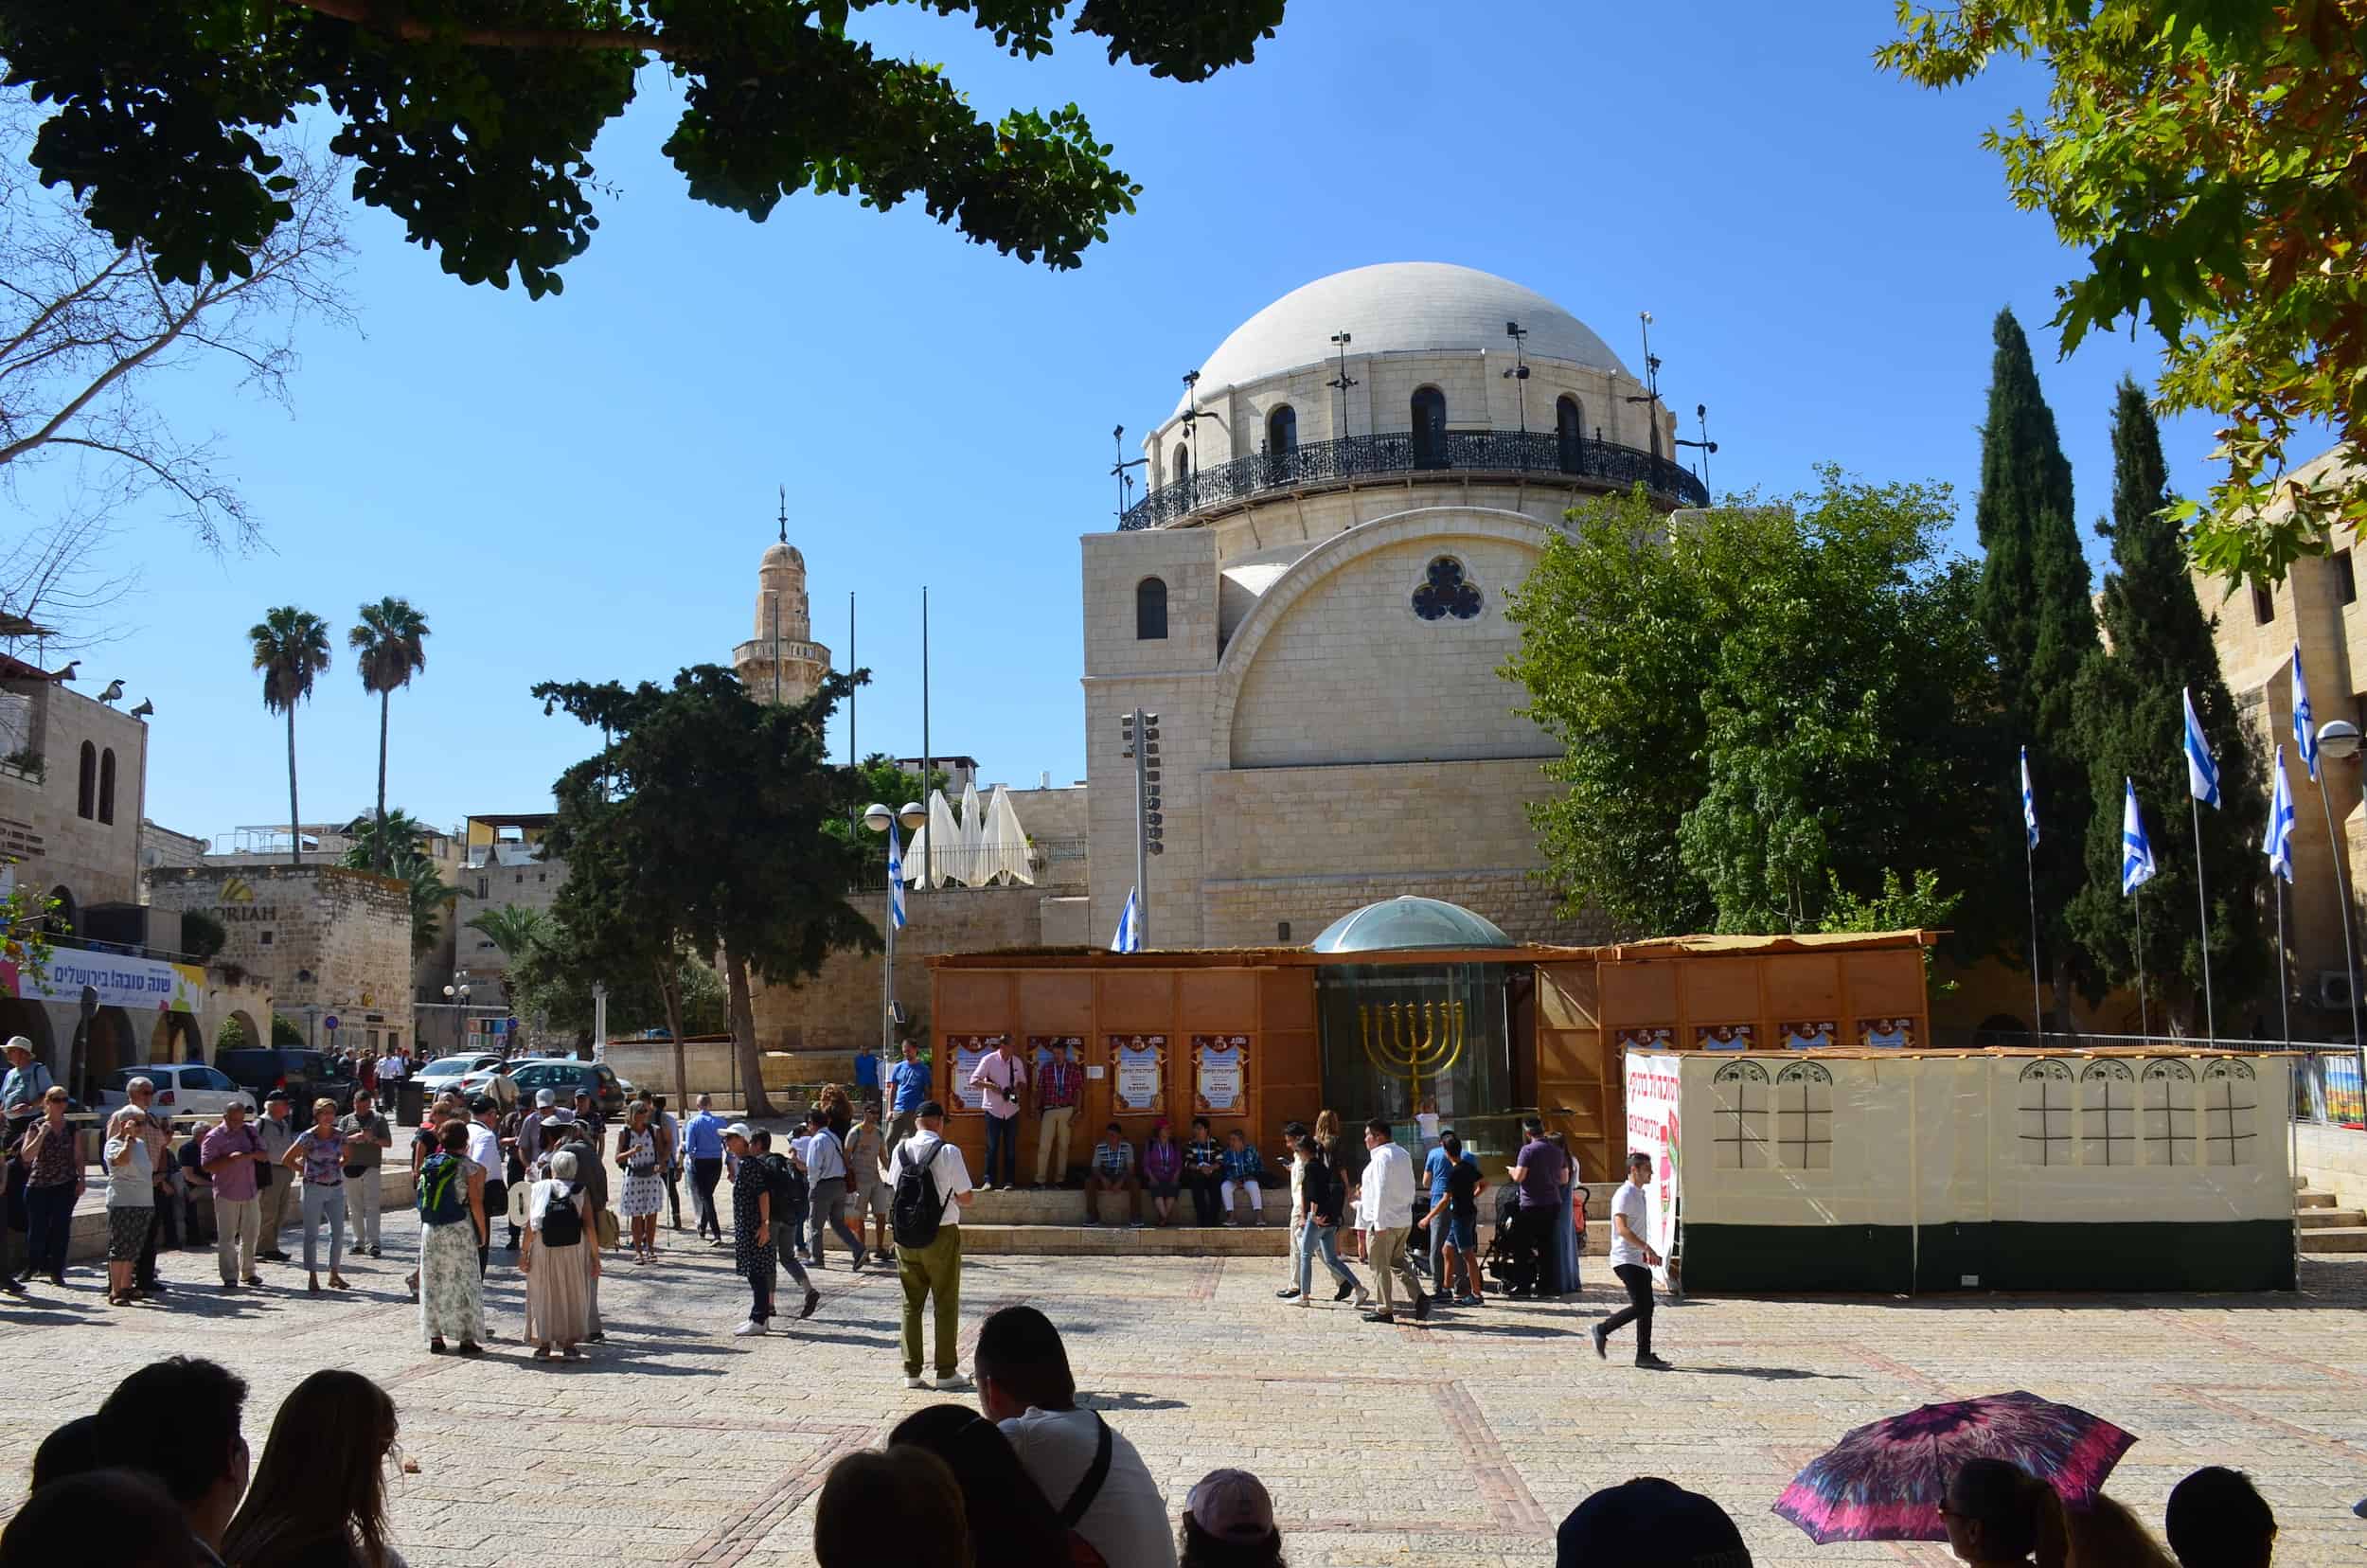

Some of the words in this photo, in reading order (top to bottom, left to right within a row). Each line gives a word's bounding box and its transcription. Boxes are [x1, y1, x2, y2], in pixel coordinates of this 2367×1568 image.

[54, 965, 109, 988] בירושלים
[111, 969, 145, 991] טובה!
[148, 976, 171, 993] שנה
